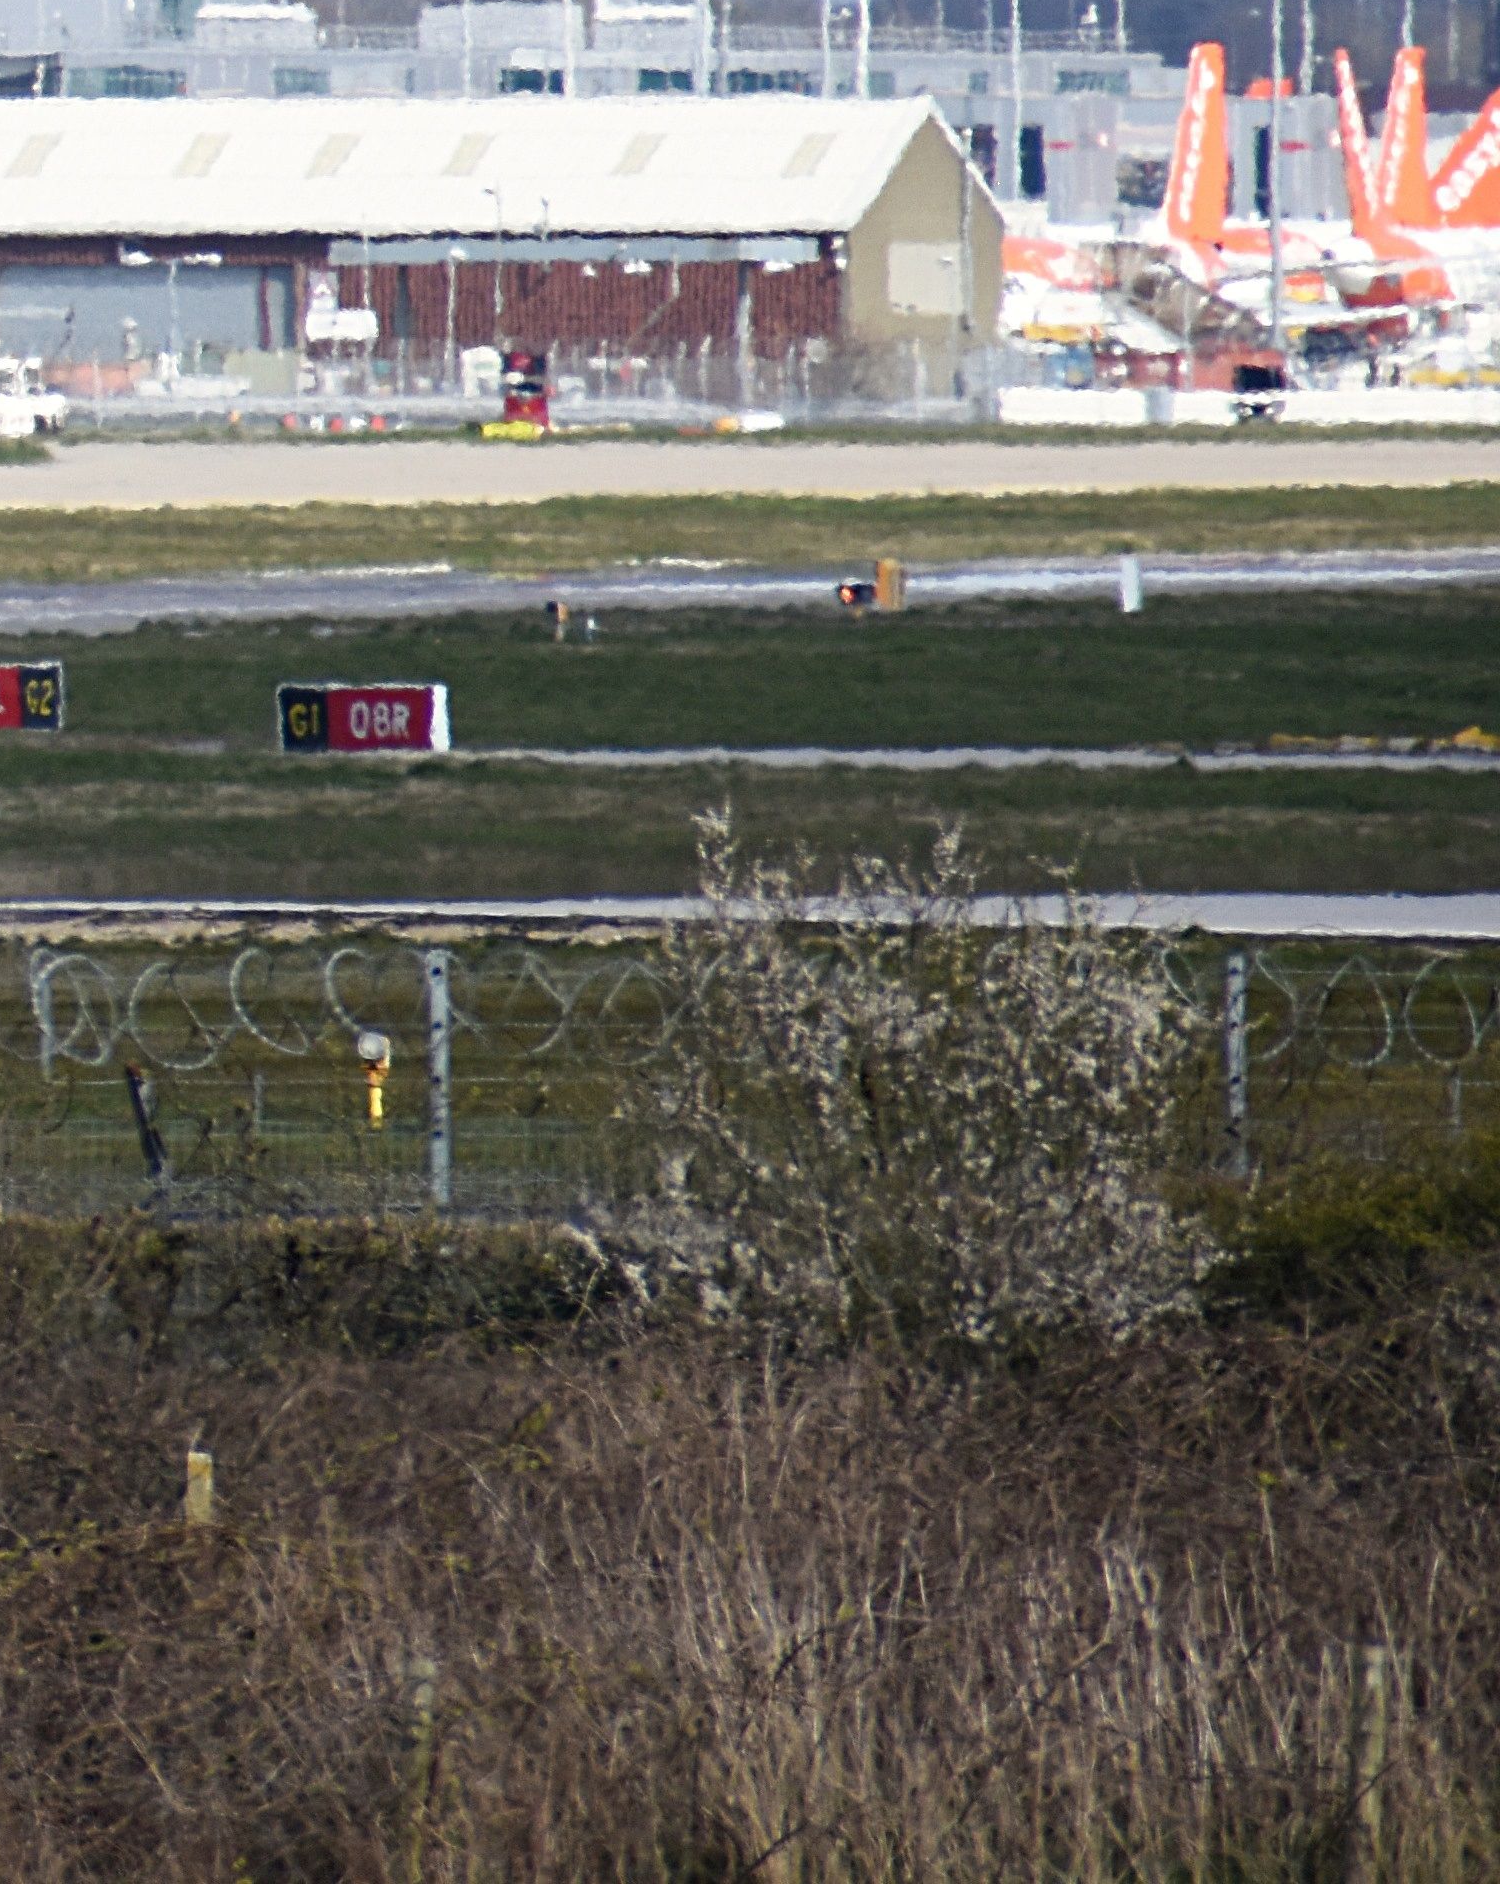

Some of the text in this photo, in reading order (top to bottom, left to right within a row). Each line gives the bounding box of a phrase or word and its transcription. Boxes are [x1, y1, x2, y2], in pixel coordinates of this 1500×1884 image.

[25, 678, 55, 717] G2
[288, 700, 411, 740] G1 08R
